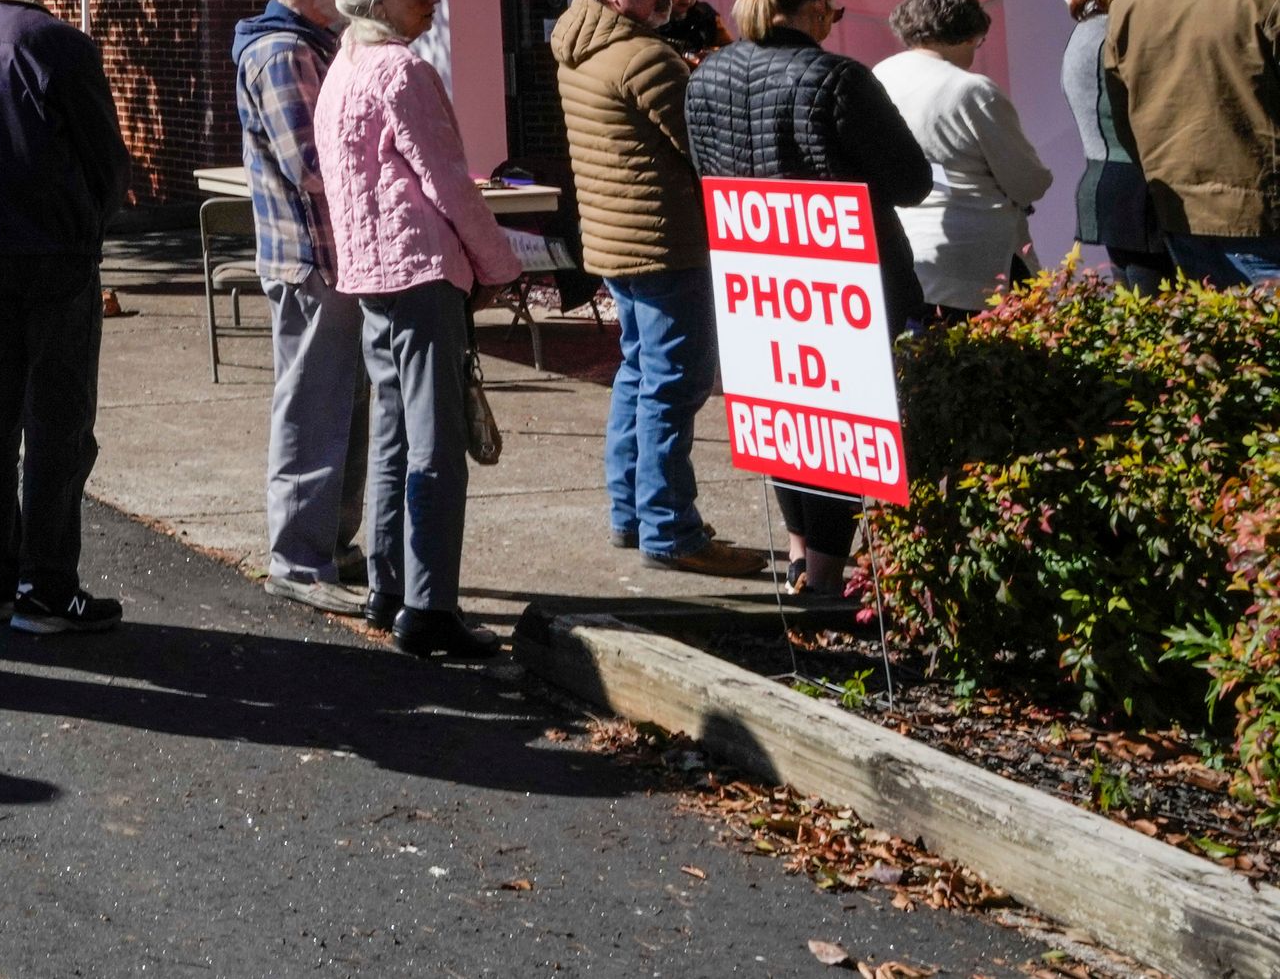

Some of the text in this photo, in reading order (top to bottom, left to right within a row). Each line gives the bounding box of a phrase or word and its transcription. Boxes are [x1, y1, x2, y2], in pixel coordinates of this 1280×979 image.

[713, 190, 865, 250] NOTICE
[725, 273, 871, 330] PHOTO
[770, 341, 840, 392] I.D.
[731, 401, 900, 485] REQUIRED
